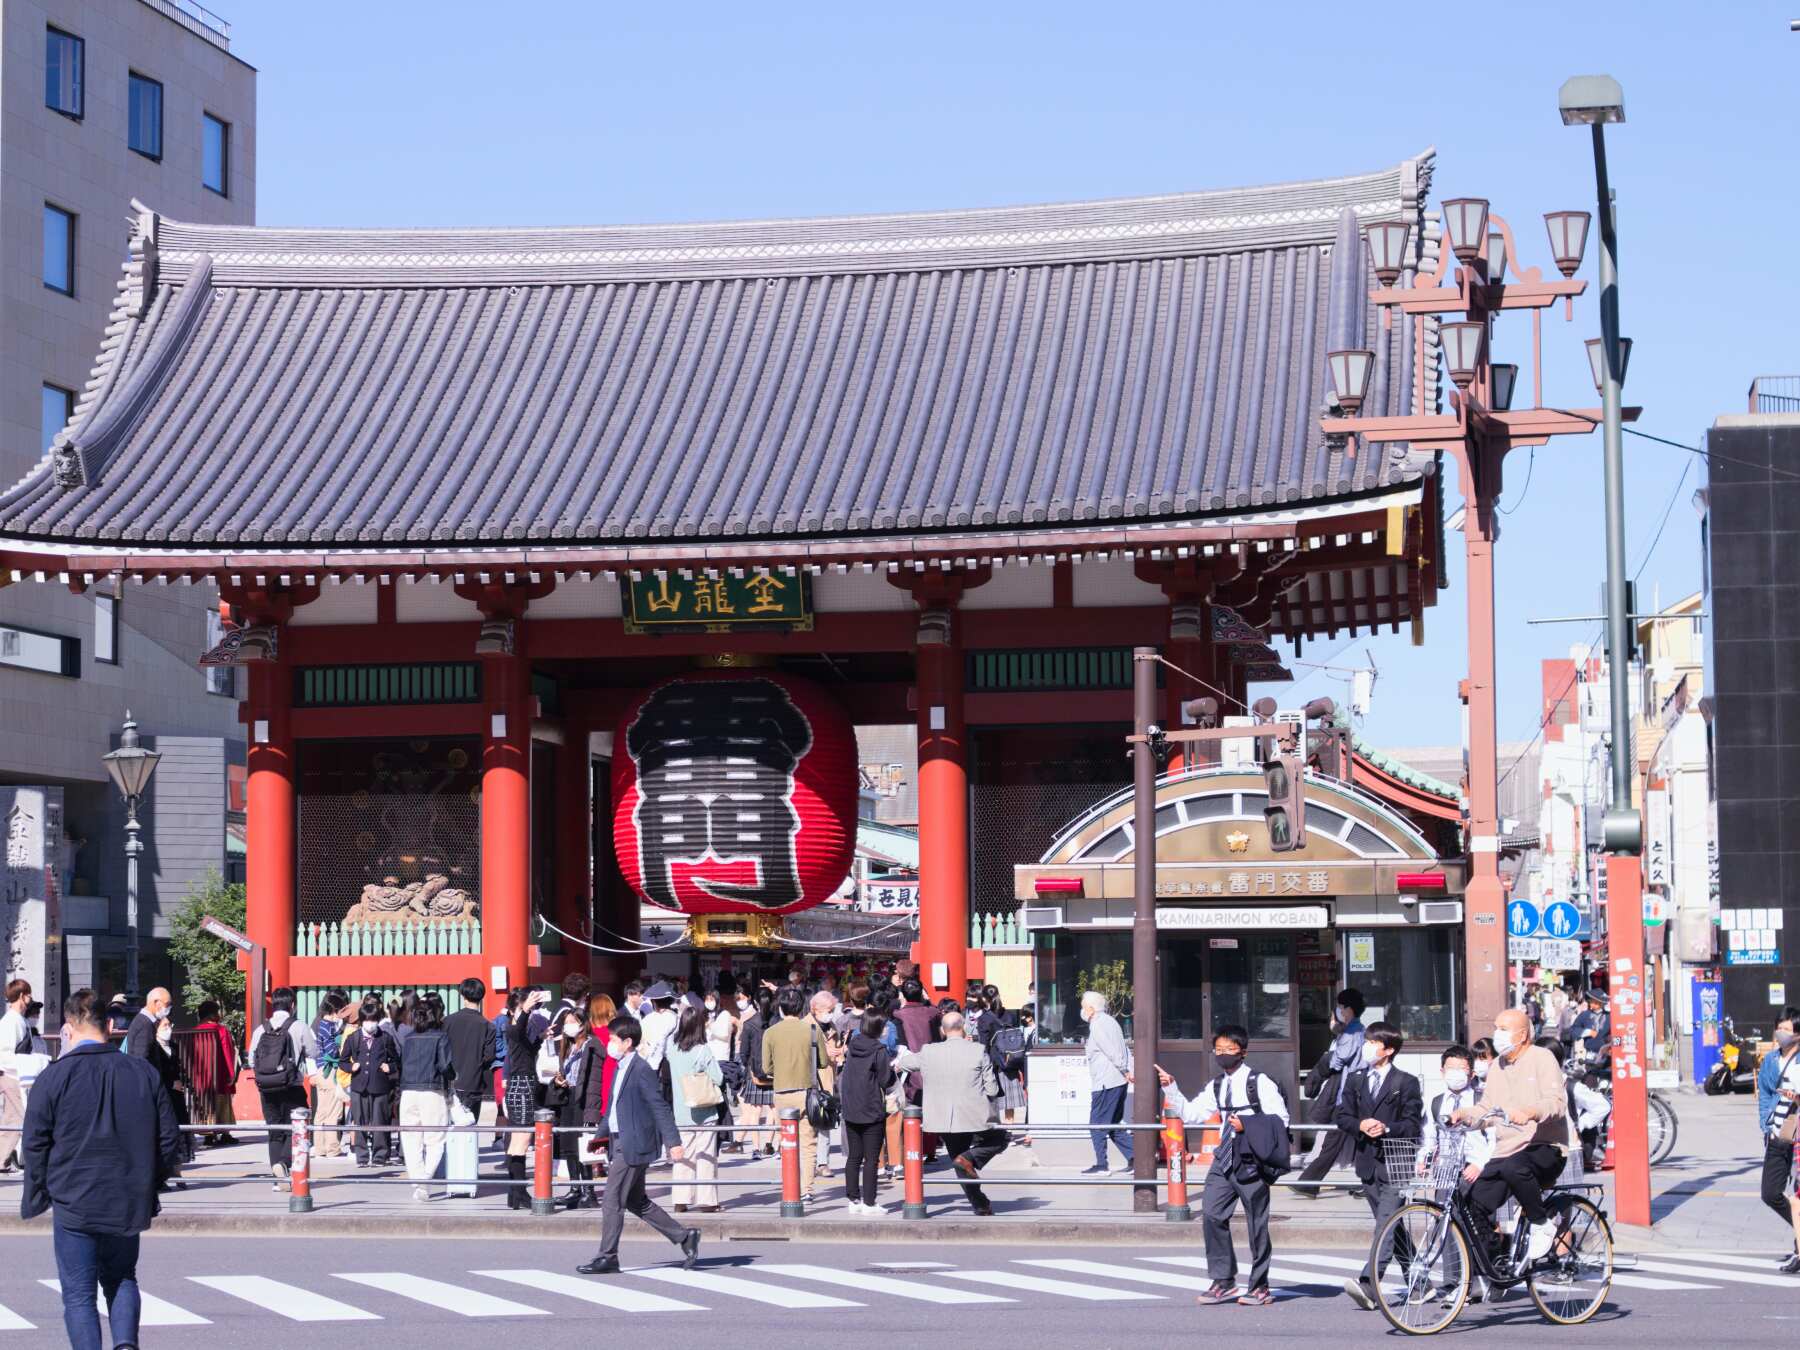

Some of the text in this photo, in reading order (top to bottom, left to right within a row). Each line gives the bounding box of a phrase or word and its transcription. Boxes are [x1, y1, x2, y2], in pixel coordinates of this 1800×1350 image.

[626, 677, 814, 910] 雷門
[1228, 871, 1329, 894] 雷門交番
[1159, 912, 1318, 925] KAMINARIMON KOBAN
